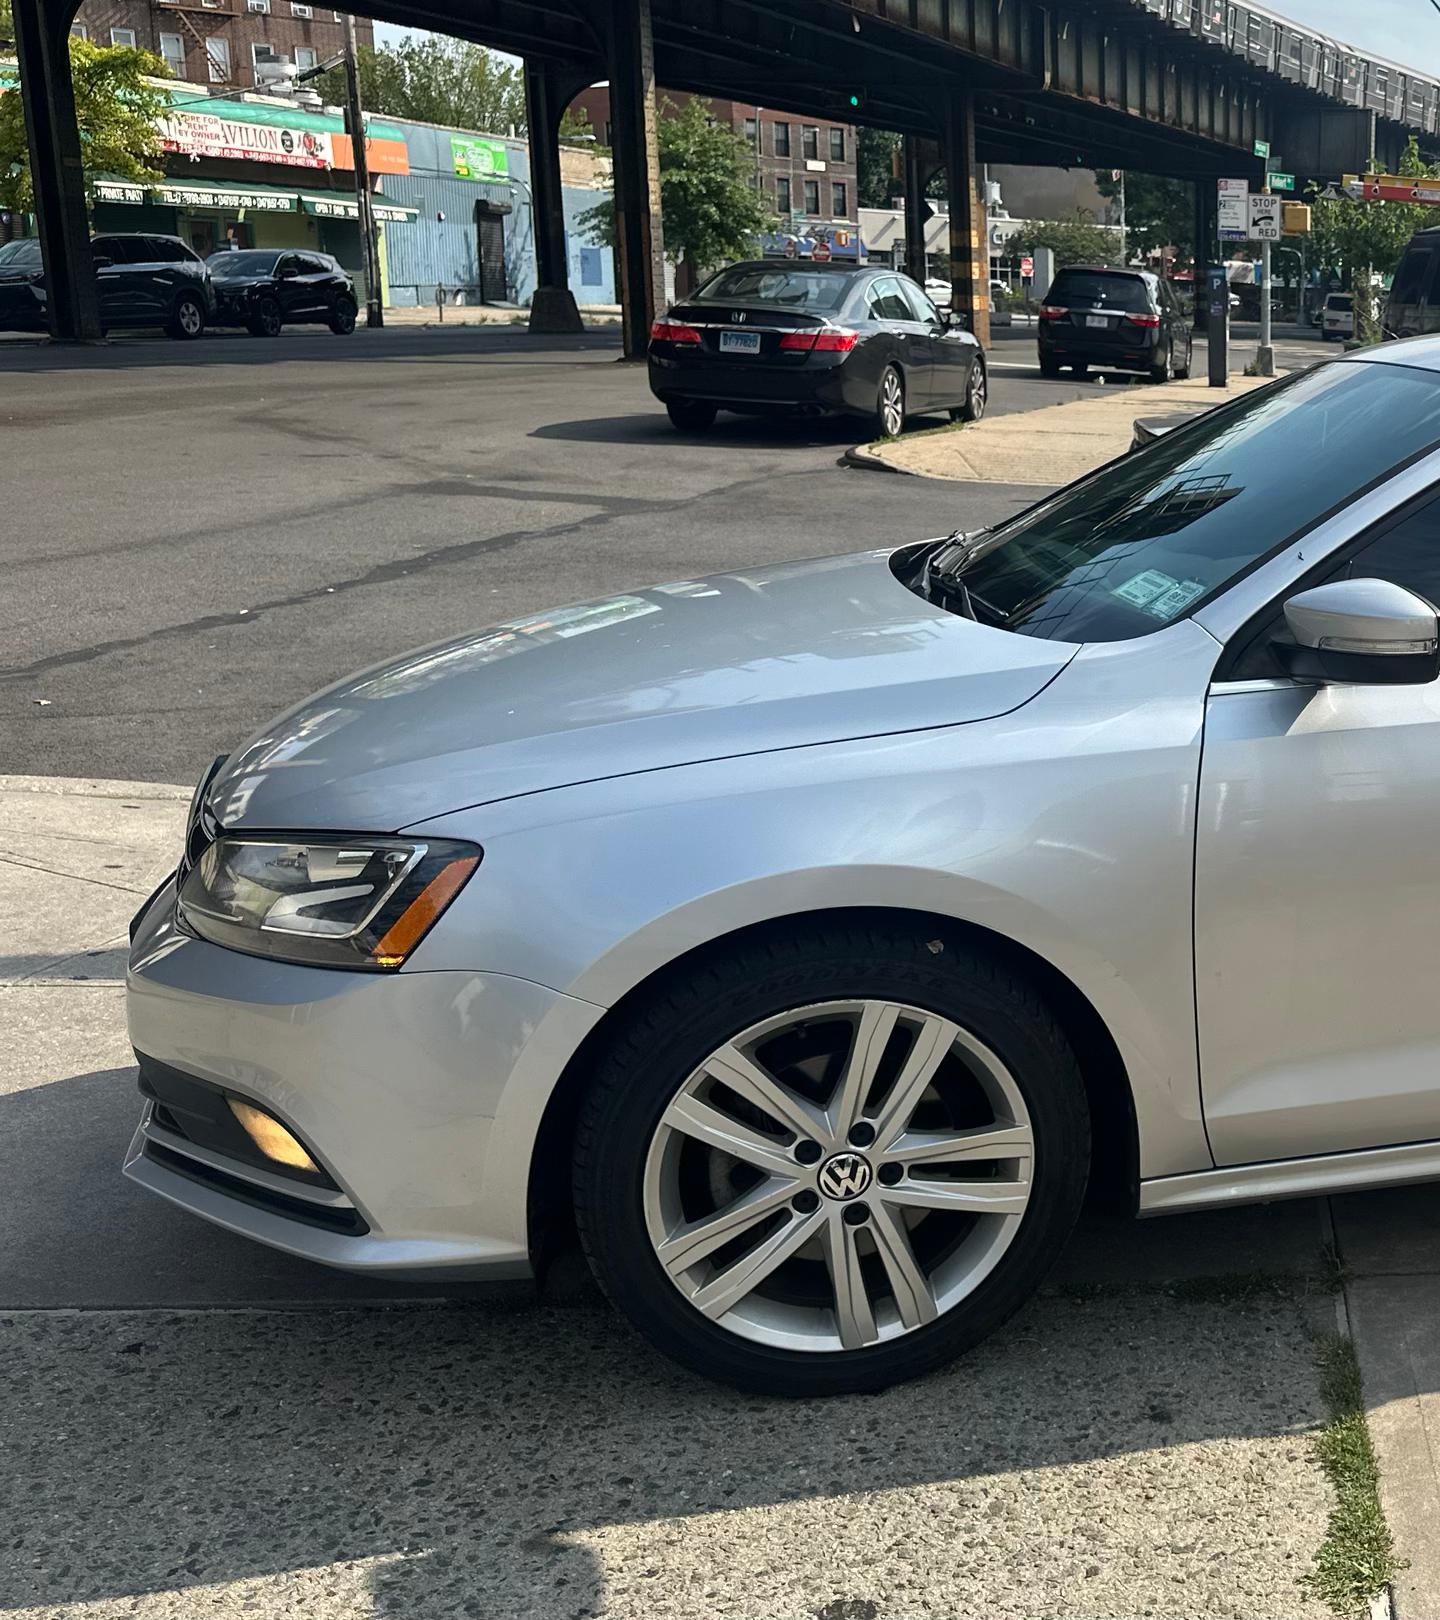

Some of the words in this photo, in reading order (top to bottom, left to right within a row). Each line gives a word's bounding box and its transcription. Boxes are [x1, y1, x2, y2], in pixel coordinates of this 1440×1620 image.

[203, 116, 219, 126] FOR
[187, 122, 208, 131] RENT
[191, 131, 221, 141] OWNER
[222, 122, 278, 150] AVILION
[1252, 198, 1277, 208] STOP
[1258, 228, 1277, 238] RED
[1213, 278, 1221, 290] P
[818, 1152, 871, 1200] VW
